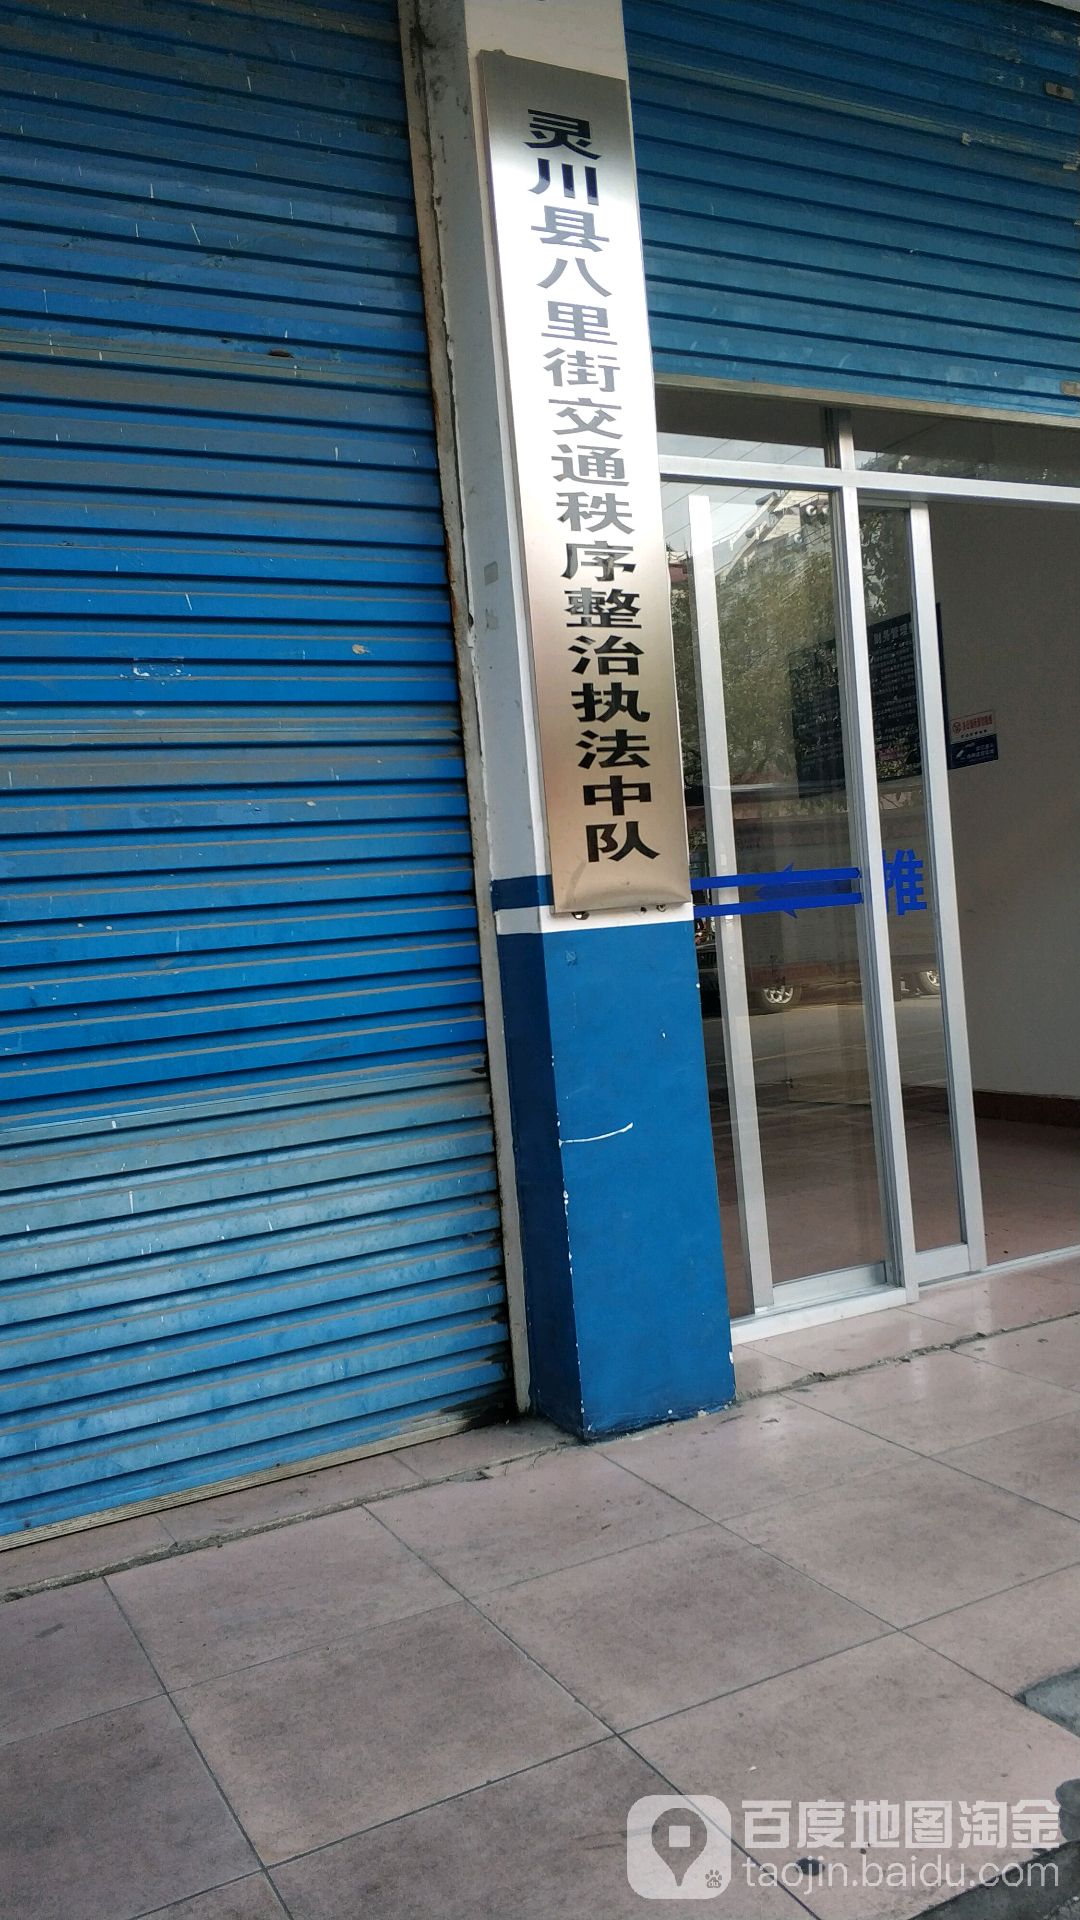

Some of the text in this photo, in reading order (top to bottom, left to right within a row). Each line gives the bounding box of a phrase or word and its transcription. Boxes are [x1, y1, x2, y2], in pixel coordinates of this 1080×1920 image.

[523, 108, 661, 863] 灵川县八里街交通秩序整治执法中队
[882, 848, 928, 915] 推
